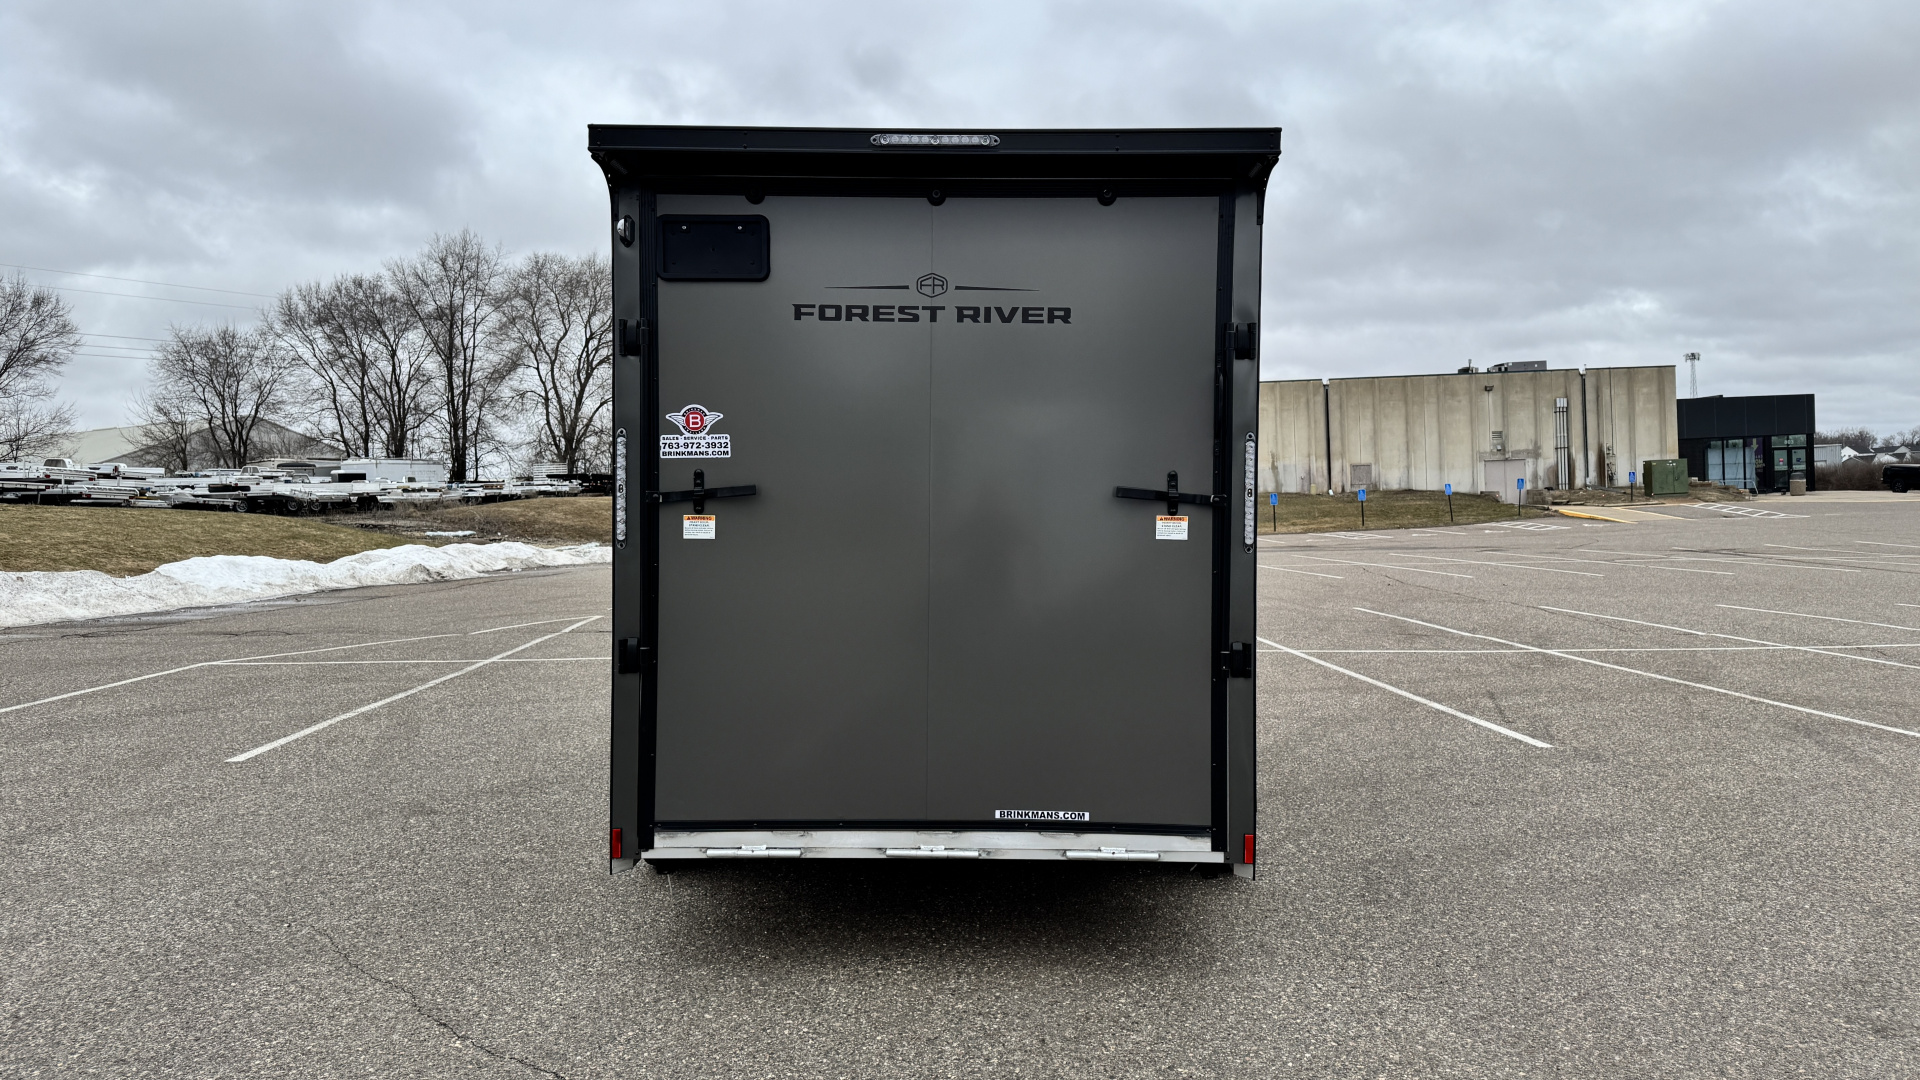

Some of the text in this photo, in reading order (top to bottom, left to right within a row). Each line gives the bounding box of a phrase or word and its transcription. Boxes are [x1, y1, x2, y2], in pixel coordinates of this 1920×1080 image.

[792, 303, 1072, 324] FOREST RIVER
[689, 414, 702, 428] B
[661, 441, 729, 450] 763-972-3932
[1000, 811, 1085, 820] BRINKMANS.COM
